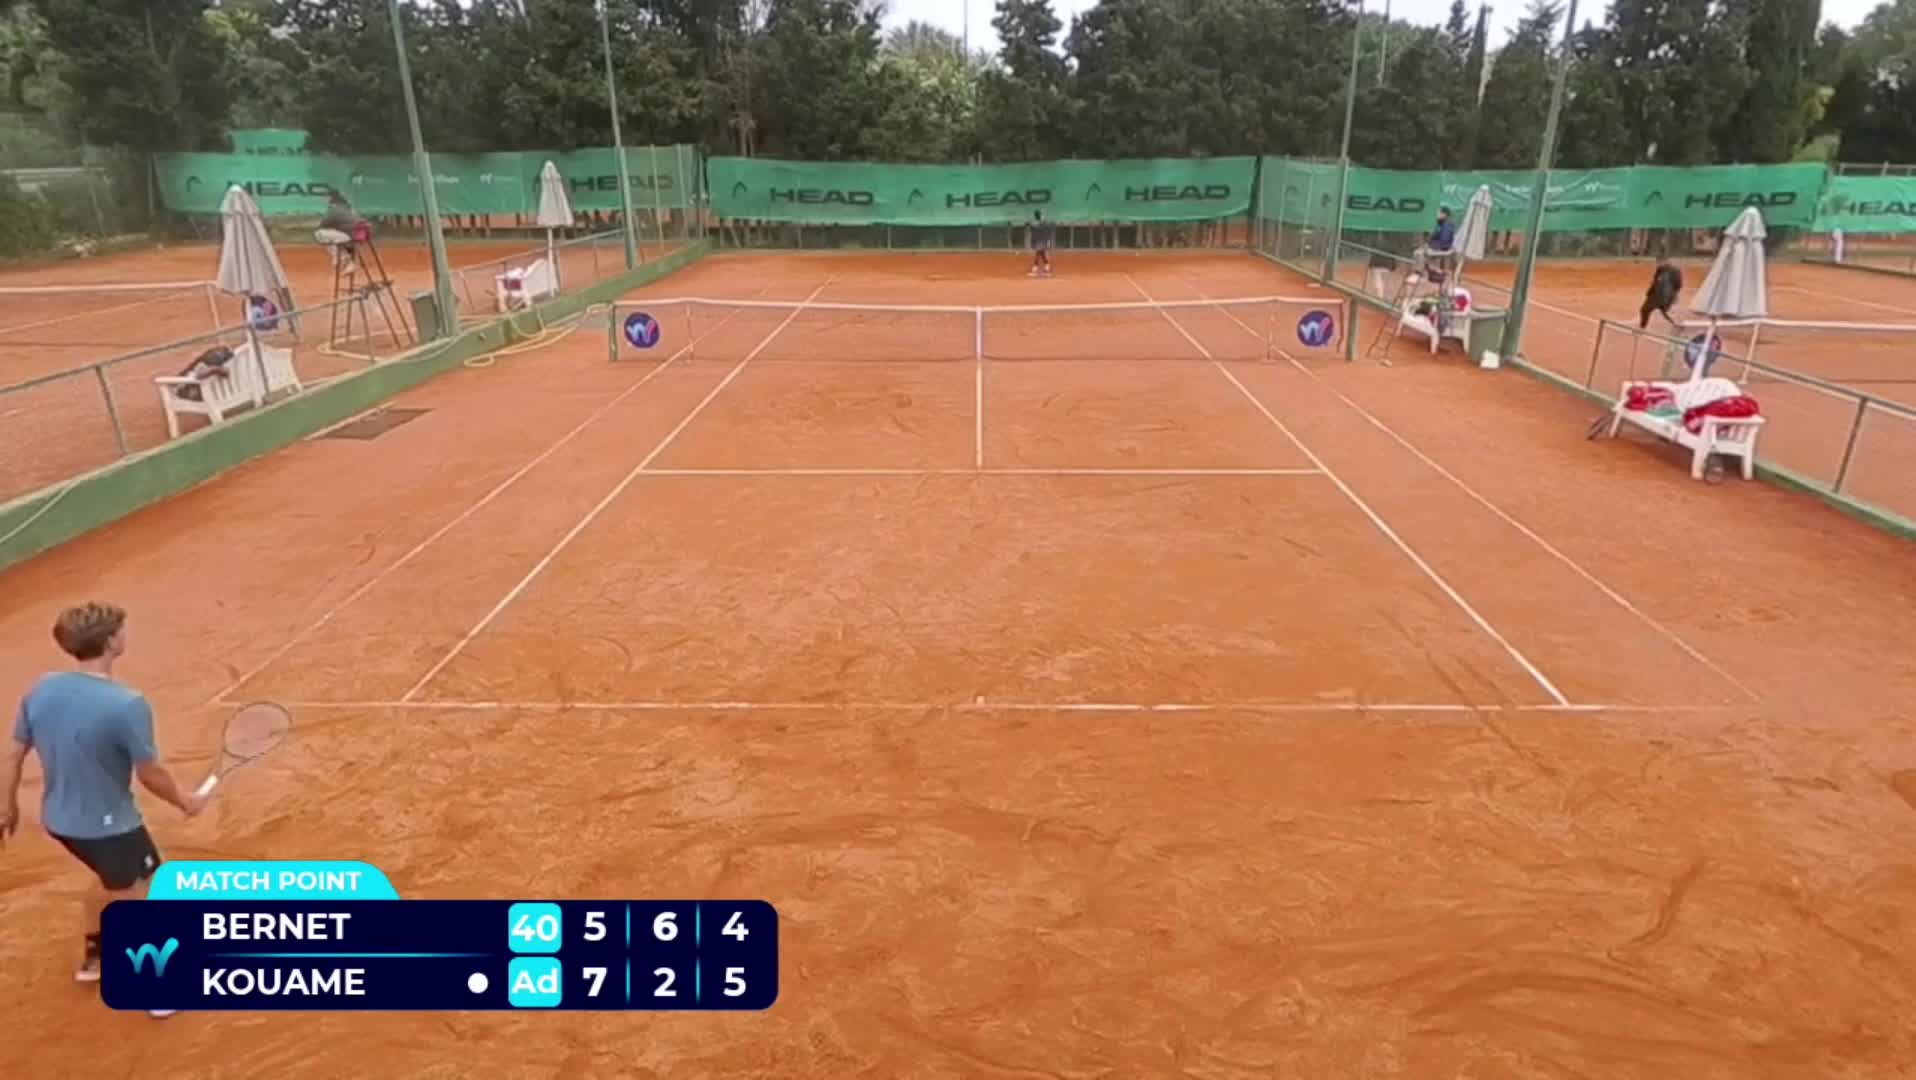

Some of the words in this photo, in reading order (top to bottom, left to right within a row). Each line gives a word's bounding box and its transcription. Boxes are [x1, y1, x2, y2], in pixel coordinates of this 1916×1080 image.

[769, 187, 874, 206] HEAD
[945, 189, 1052, 208] HEAD
[1124, 185, 1231, 201] HEAD
[1684, 191, 1797, 208] HEAD
